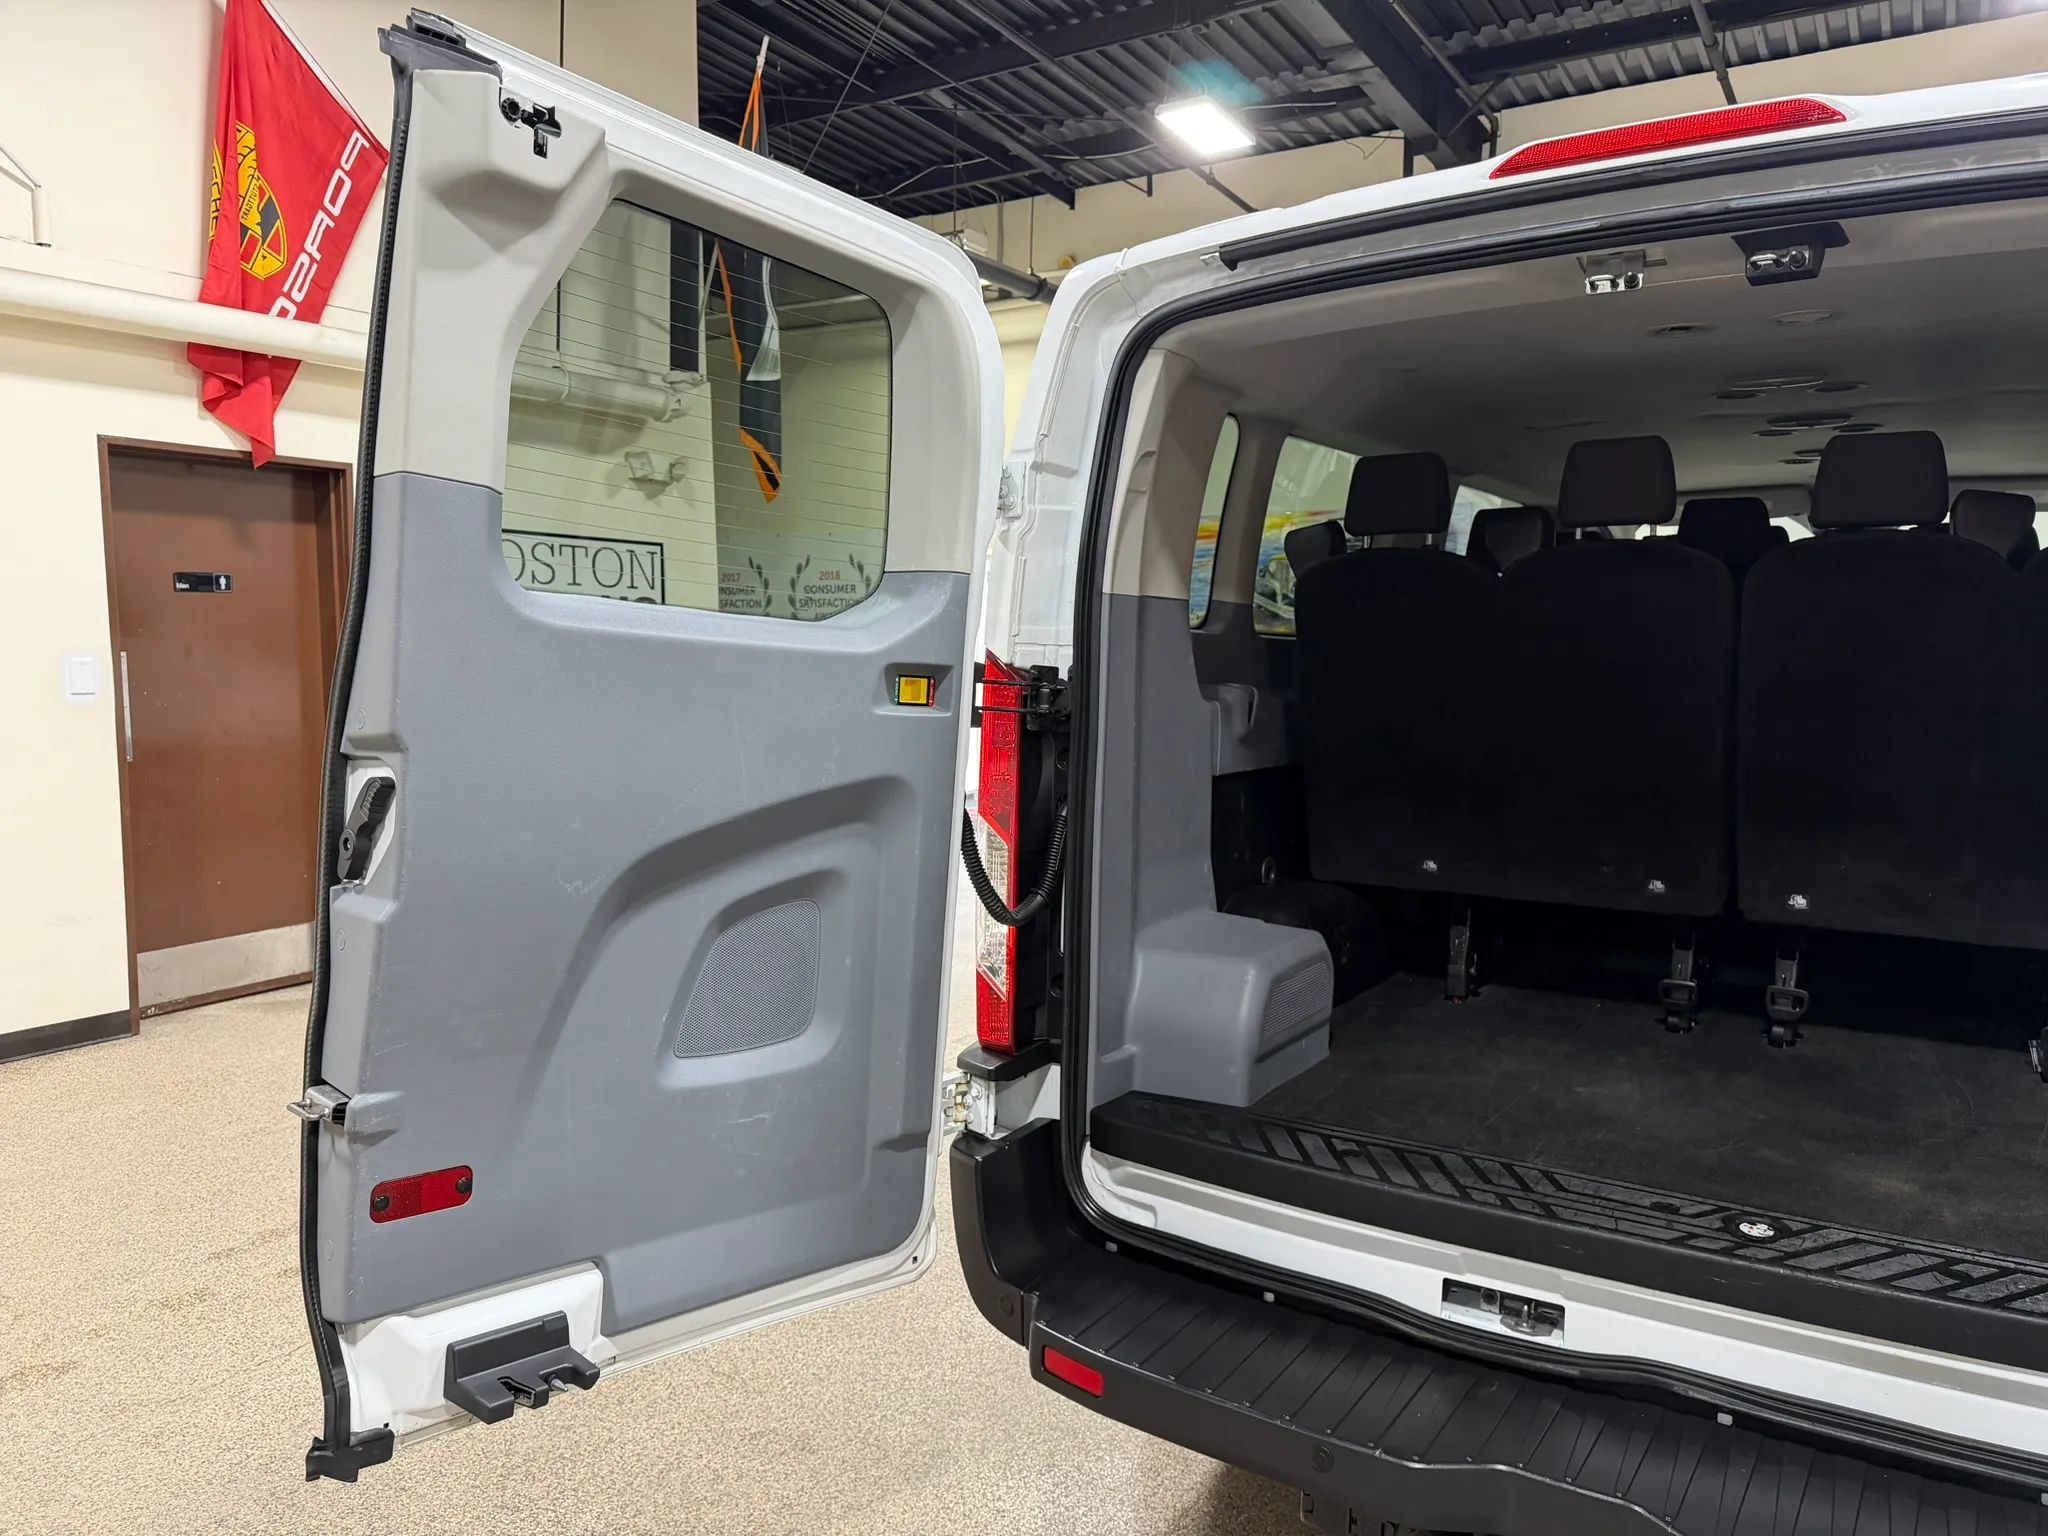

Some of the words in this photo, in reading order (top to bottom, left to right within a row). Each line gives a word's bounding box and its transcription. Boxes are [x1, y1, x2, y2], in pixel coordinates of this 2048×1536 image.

[721, 572, 741, 583] 2017
[819, 570, 841, 580] 2018
[803, 584, 856, 594] CONSUMER
